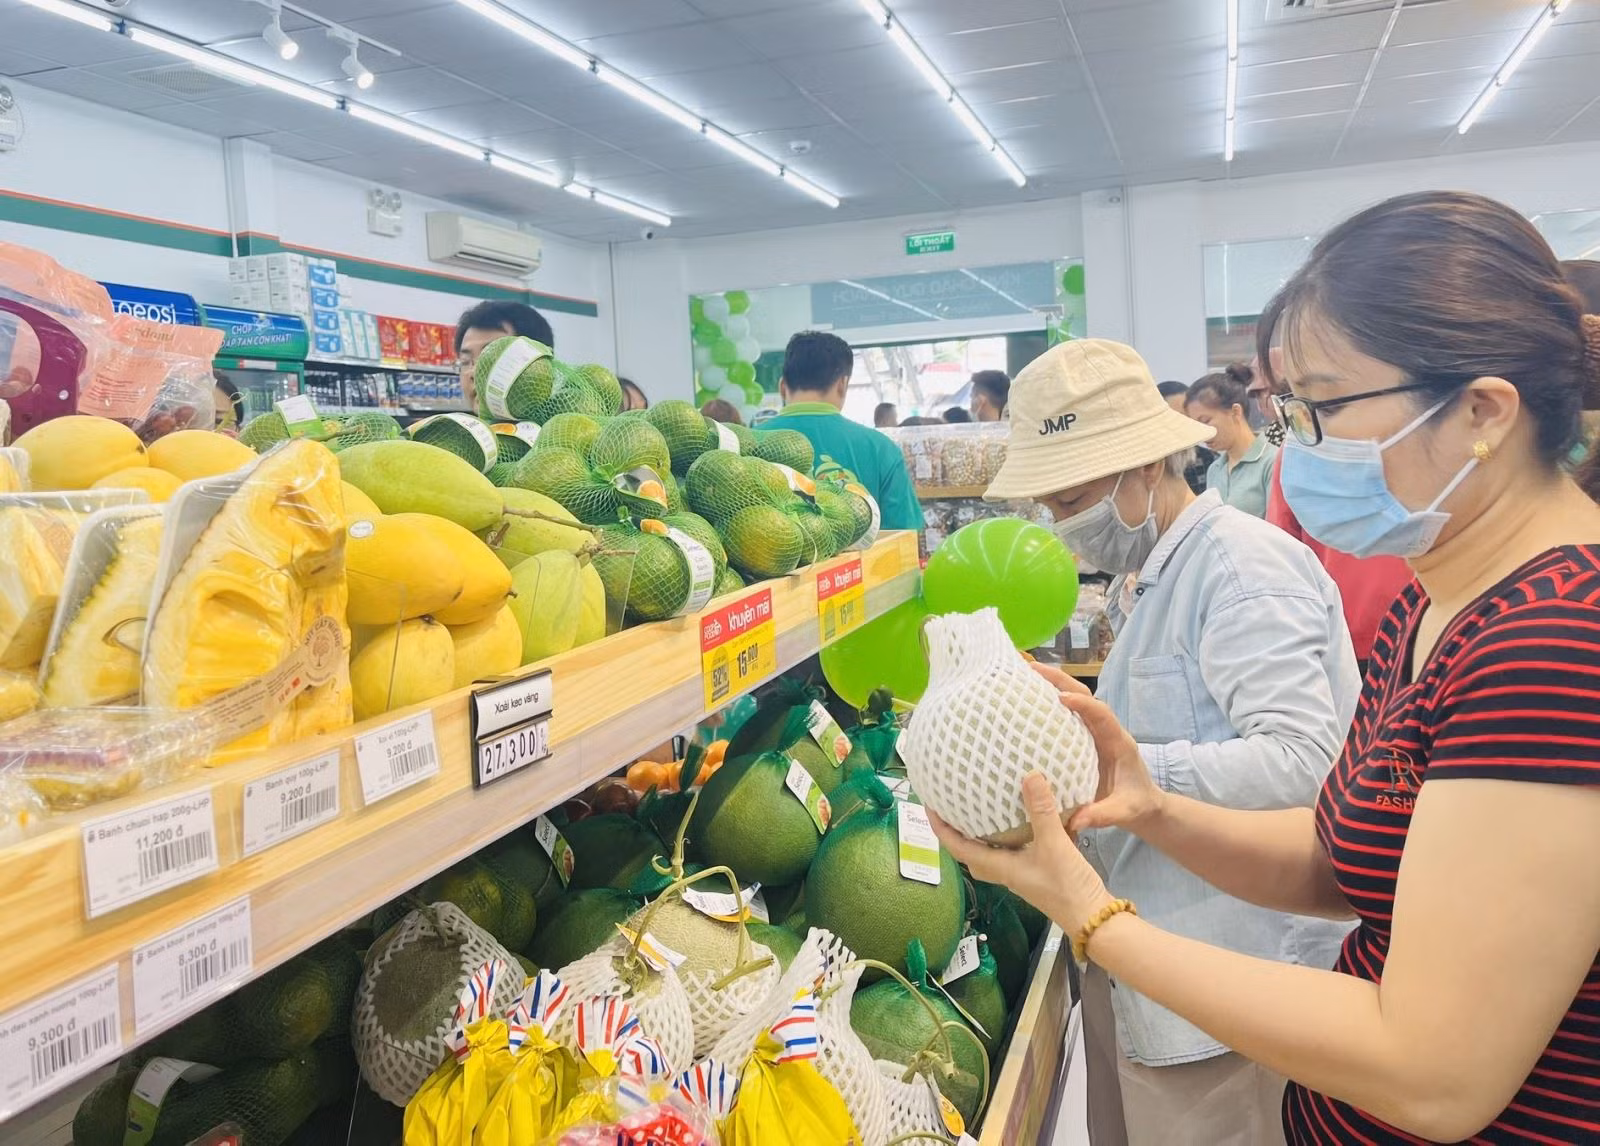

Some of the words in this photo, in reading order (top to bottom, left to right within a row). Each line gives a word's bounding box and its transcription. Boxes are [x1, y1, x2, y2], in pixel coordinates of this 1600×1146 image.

[1039, 413, 1076, 435] JMP
[485, 730, 536, 774] 27.300
[280, 786, 304, 804] 9.200
[305, 783, 311, 795] đ
[176, 825, 184, 837] đ
[178, 943, 206, 966] 8.300
[209, 938, 217, 951] đ
[28, 1024, 64, 1051] 9.300
[67, 1017, 76, 1032] đ
